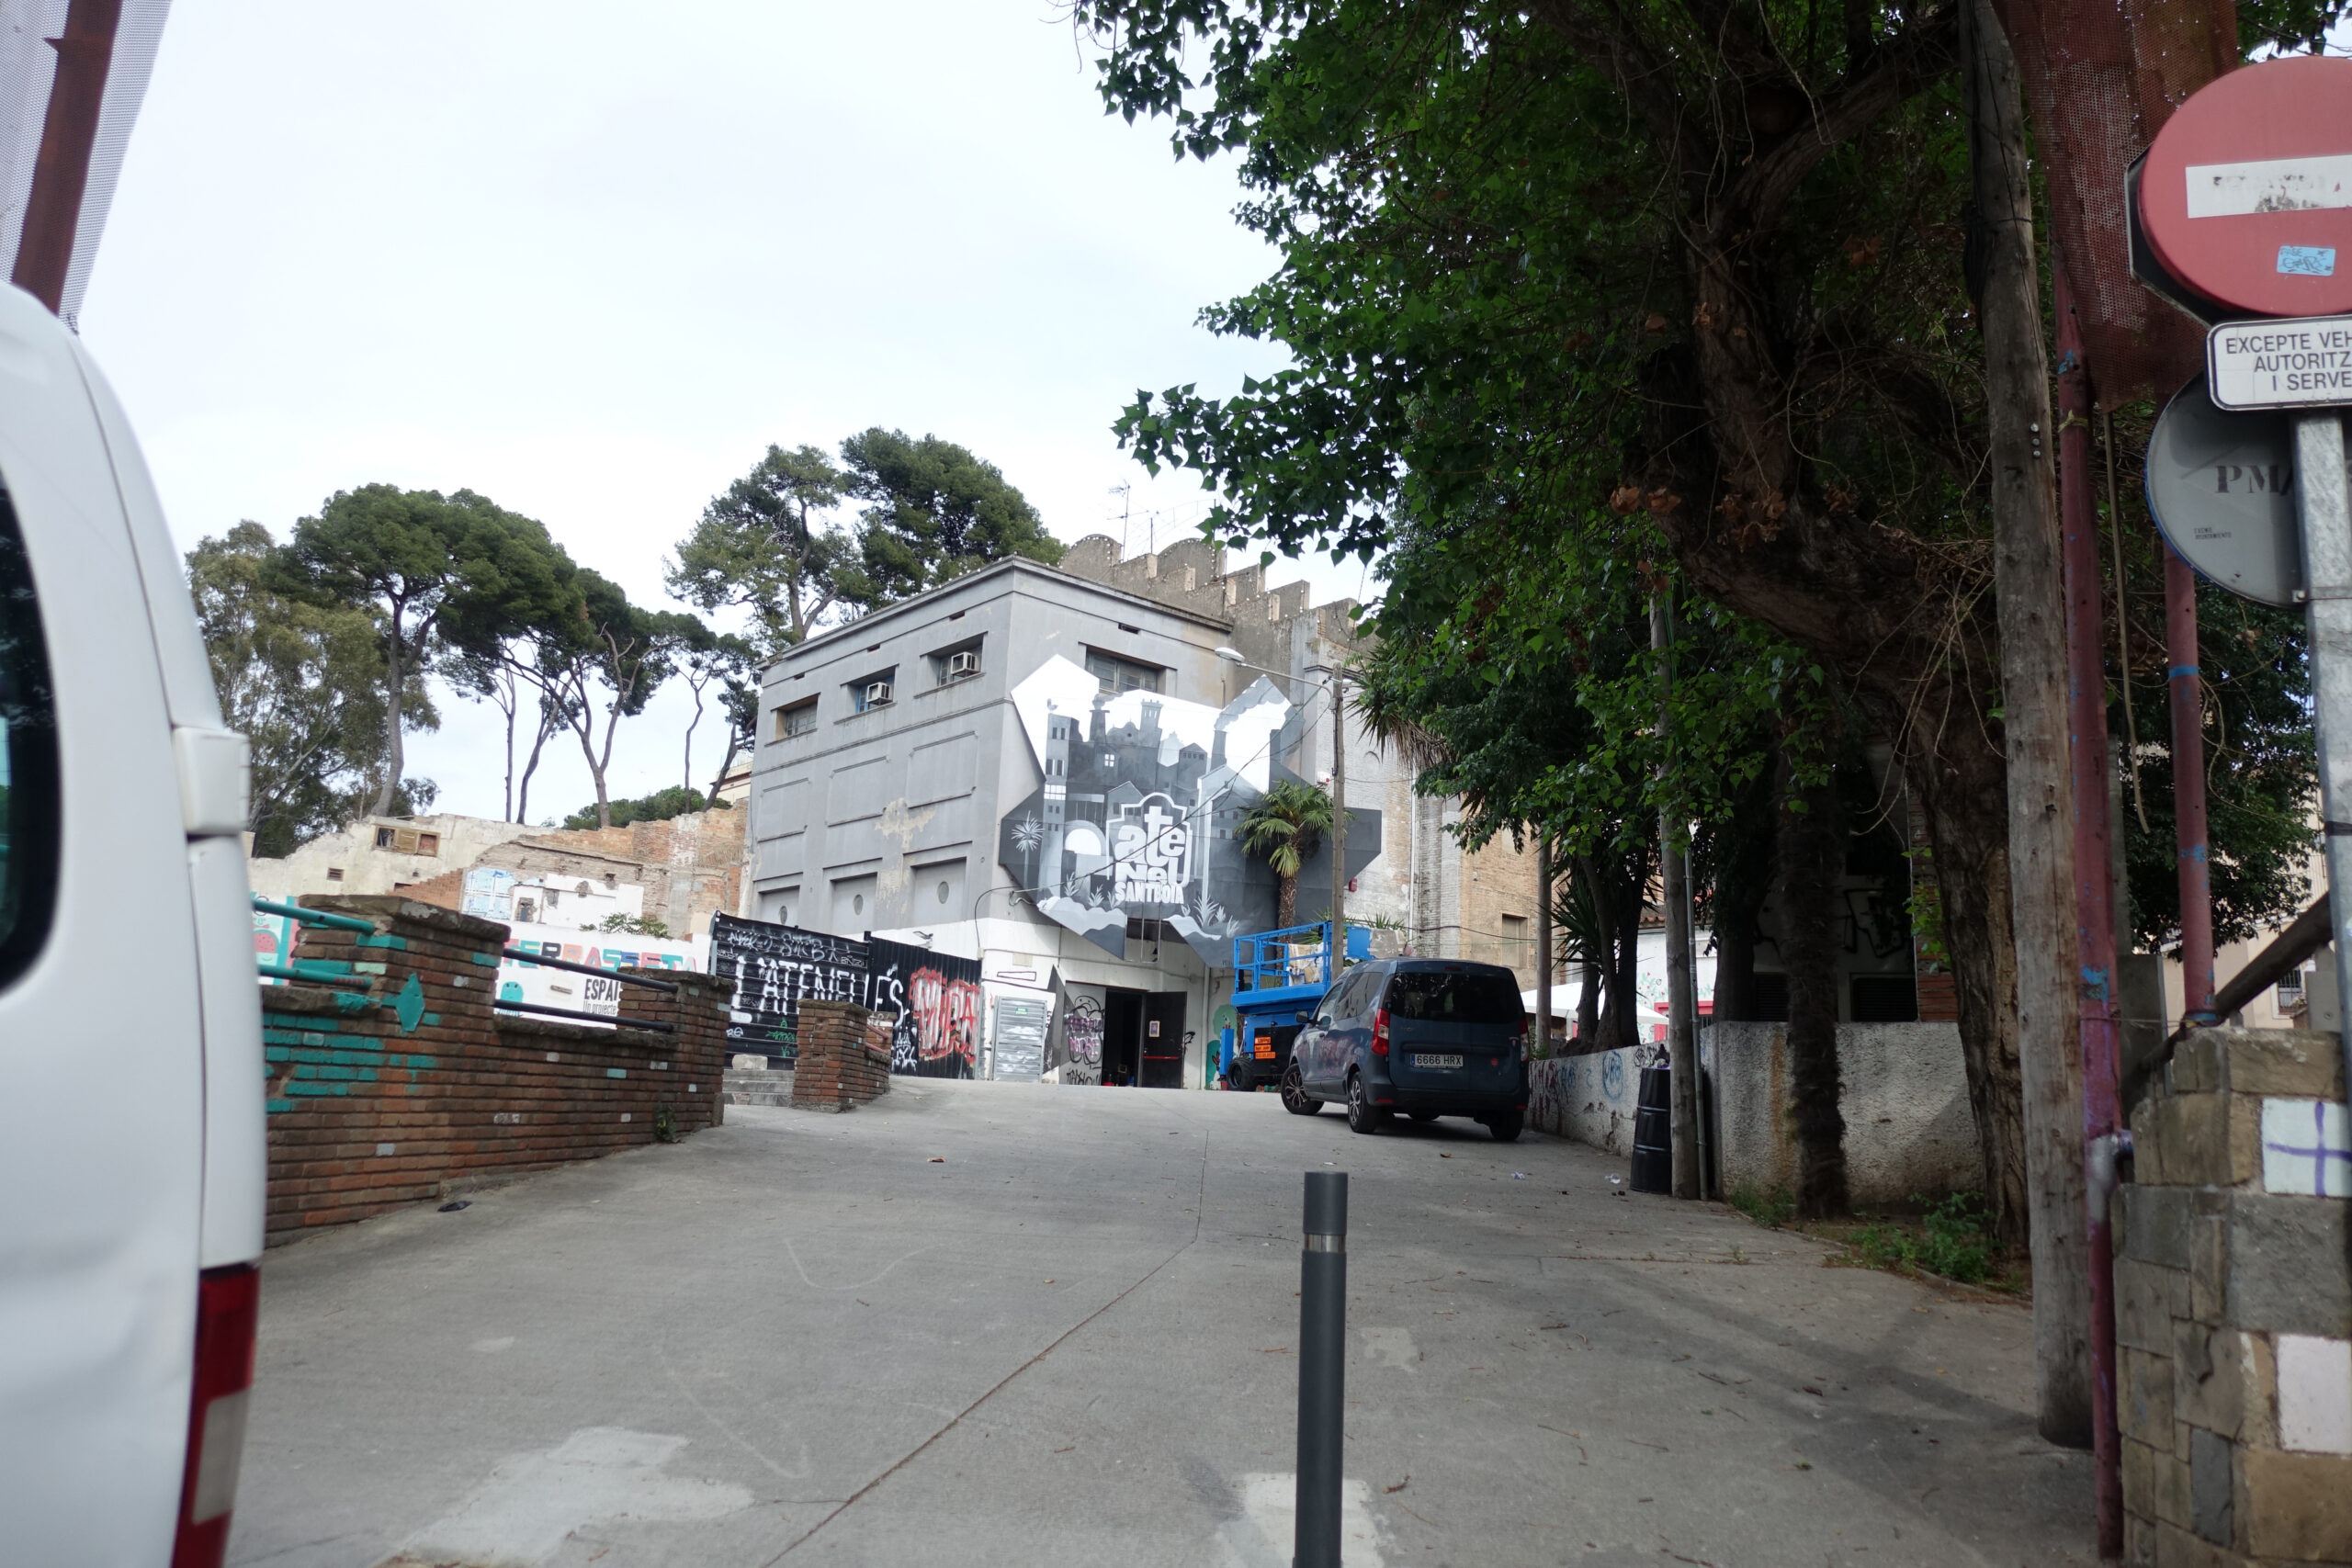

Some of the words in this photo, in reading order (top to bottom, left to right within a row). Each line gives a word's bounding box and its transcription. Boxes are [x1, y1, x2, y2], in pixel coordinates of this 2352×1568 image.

[2226, 333, 2312, 355] EXCEPTE
[2254, 351, 2352, 373] AUTORITZ
[2272, 375, 2277, 391] I
[2287, 370, 2352, 391] SERVE
[584, 978, 619, 1001] ESPAI
[1416, 1055, 1441, 1065] 6666
[1443, 1055, 1462, 1066] HRX
